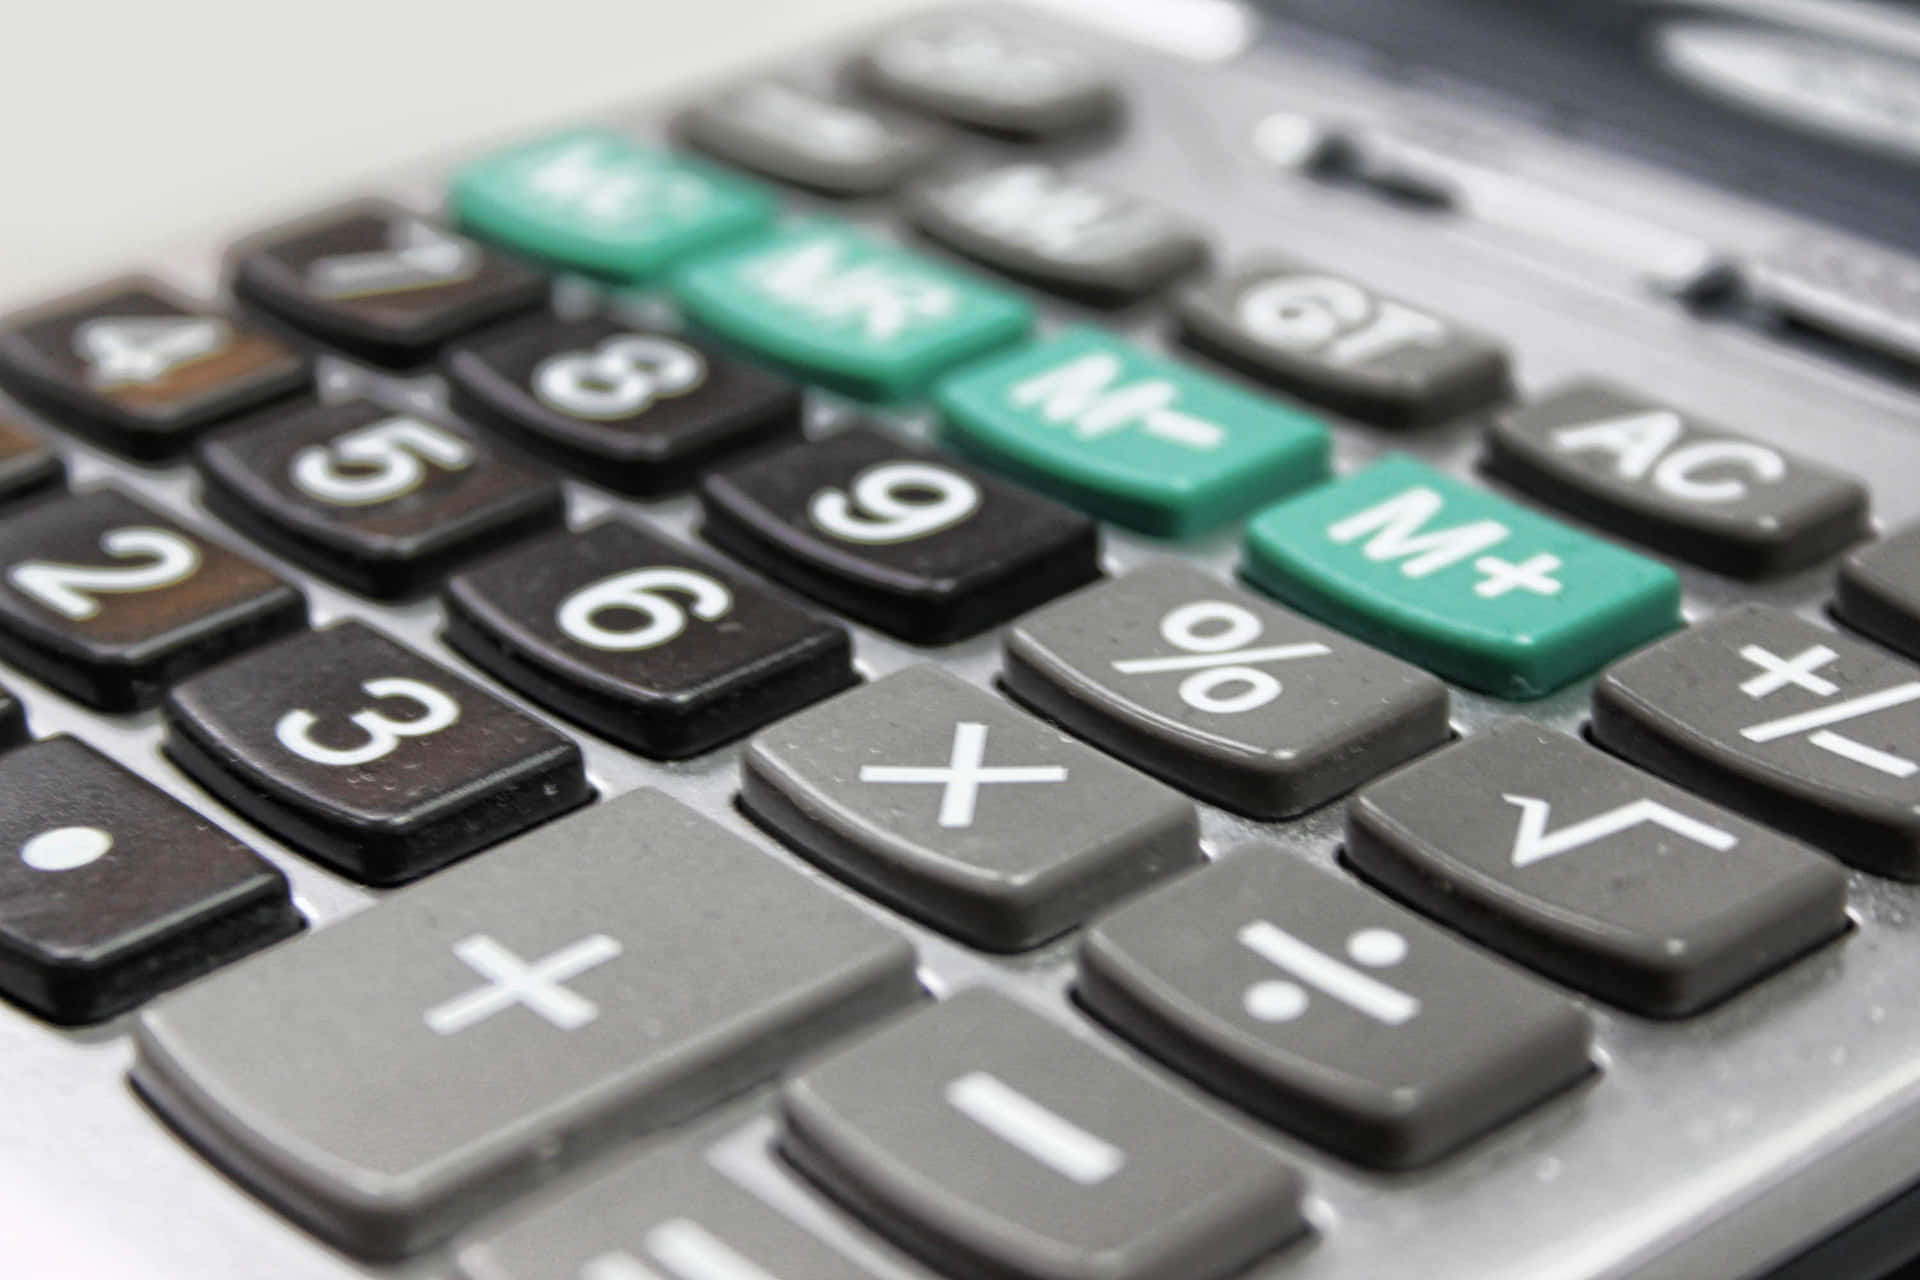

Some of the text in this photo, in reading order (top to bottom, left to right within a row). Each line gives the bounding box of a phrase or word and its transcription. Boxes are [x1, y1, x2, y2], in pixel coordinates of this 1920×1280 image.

[78, 312, 230, 384] 4
[1238, 274, 1450, 366] GT
[532, 334, 706, 418] 8
[292, 417, 478, 503] 5
[1552, 410, 1786, 502] AC
[812, 462, 981, 544] 9
[1327, 490, 1563, 598] M+
[8, 528, 198, 618] 2
[557, 568, 732, 650] 6
[1111, 600, 1332, 713] %
[276, 678, 460, 766] 3
